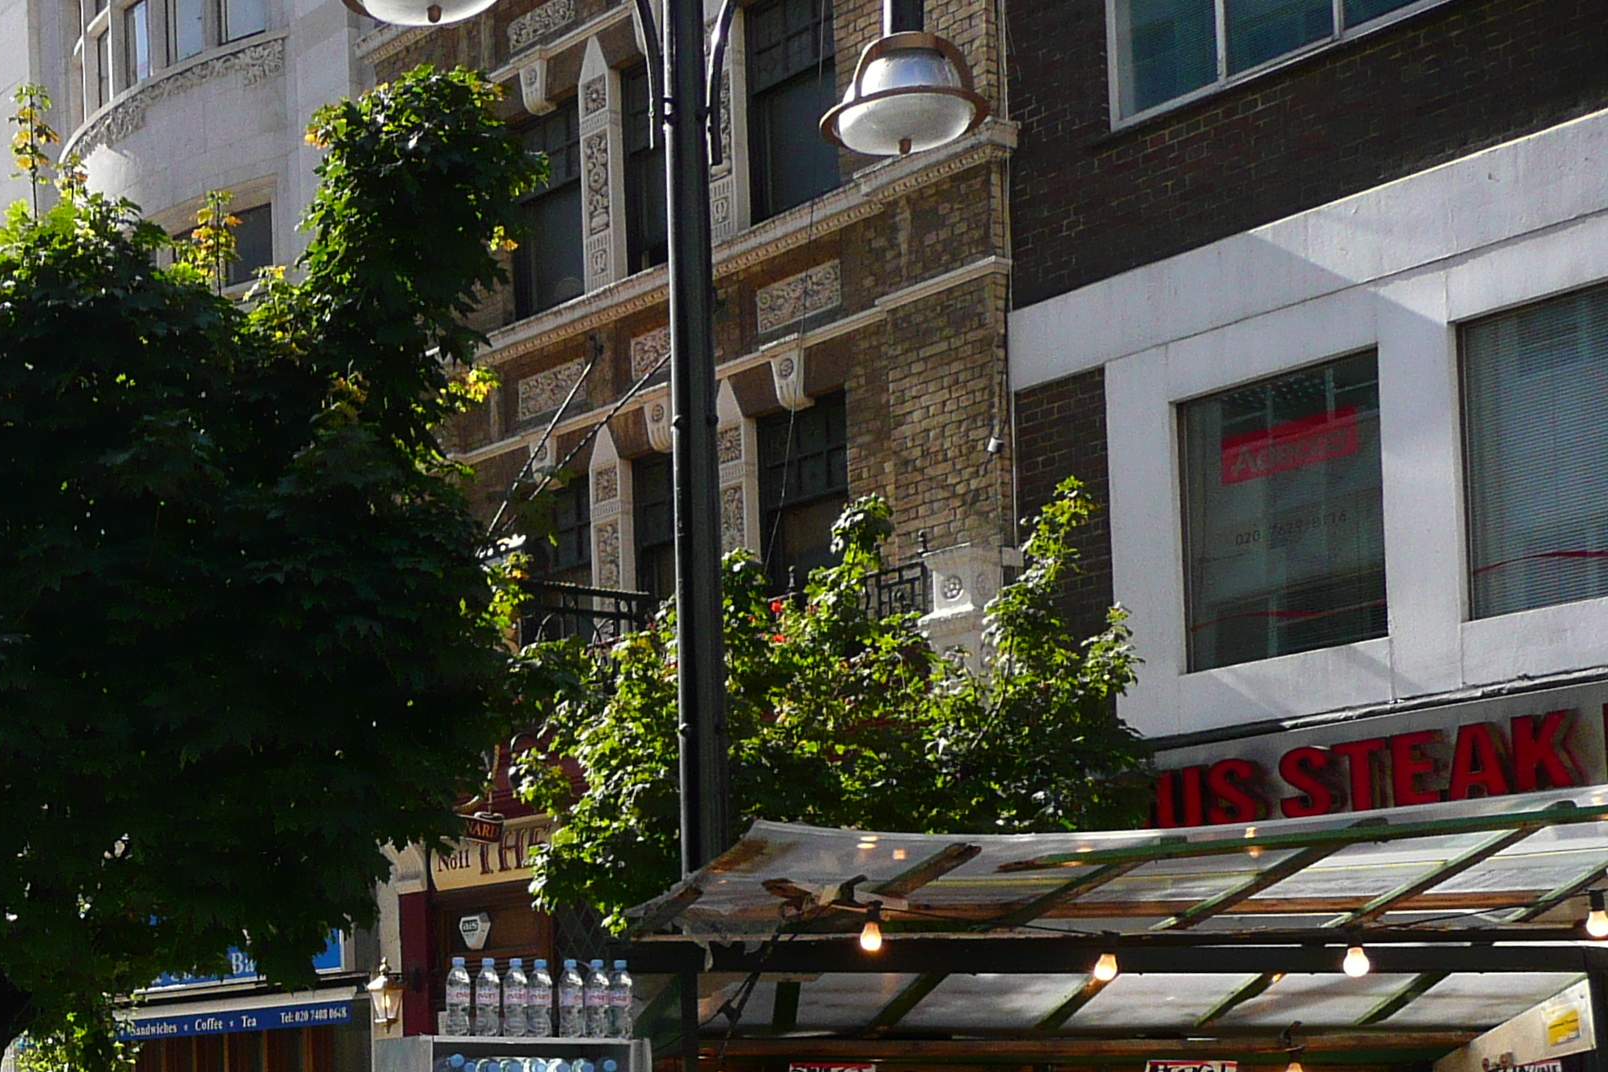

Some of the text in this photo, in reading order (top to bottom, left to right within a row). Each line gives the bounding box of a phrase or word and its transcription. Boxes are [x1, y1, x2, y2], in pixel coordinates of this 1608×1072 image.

[1150, 708, 1578, 829] US STEAK
[130, 1020, 177, 1036] Sandwiches
[195, 1017, 223, 1031] Coffee
[241, 1015, 257, 1028] Tea
[295, 1009, 309, 1022] 020
